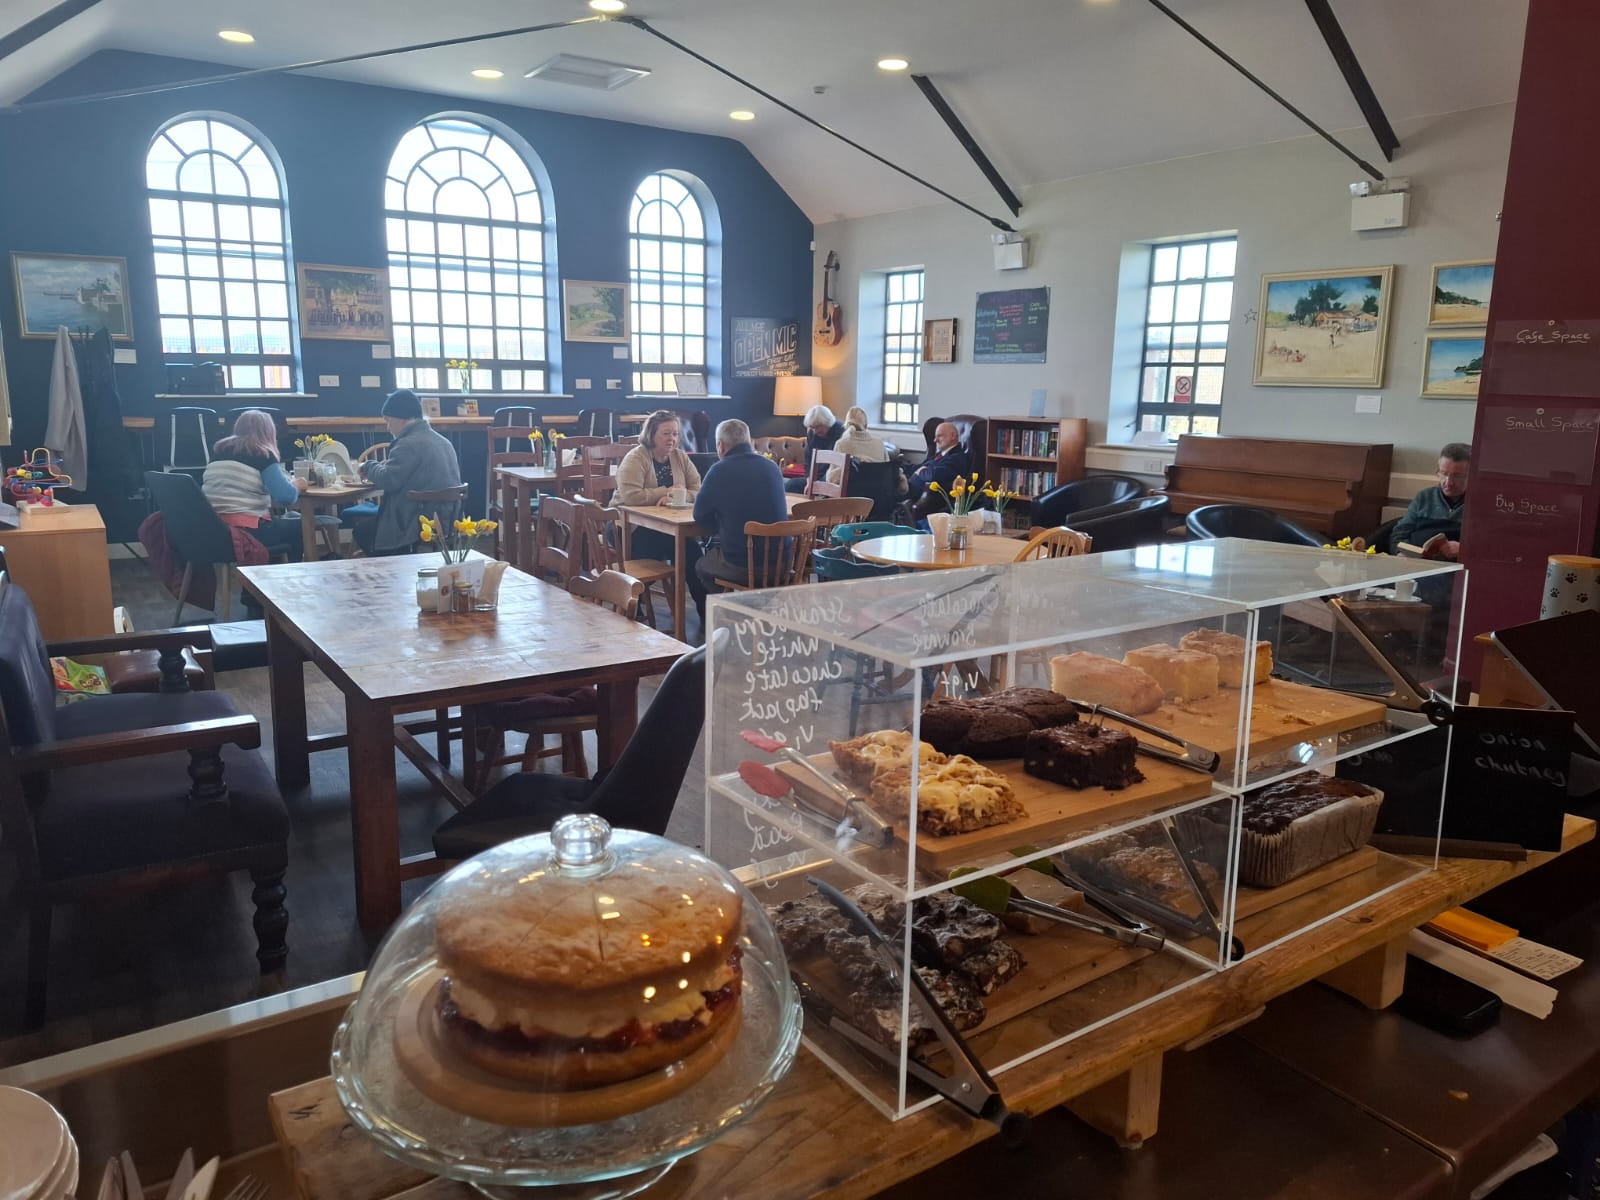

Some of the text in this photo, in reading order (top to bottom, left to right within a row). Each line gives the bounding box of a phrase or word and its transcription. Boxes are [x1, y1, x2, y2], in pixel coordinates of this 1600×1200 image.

[1516, 329, 1591, 344] Cafe Space
[735, 324, 798, 368] OPEN MIC
[1505, 416, 1594, 432] Small Space
[1495, 494, 1560, 512] Big Space
